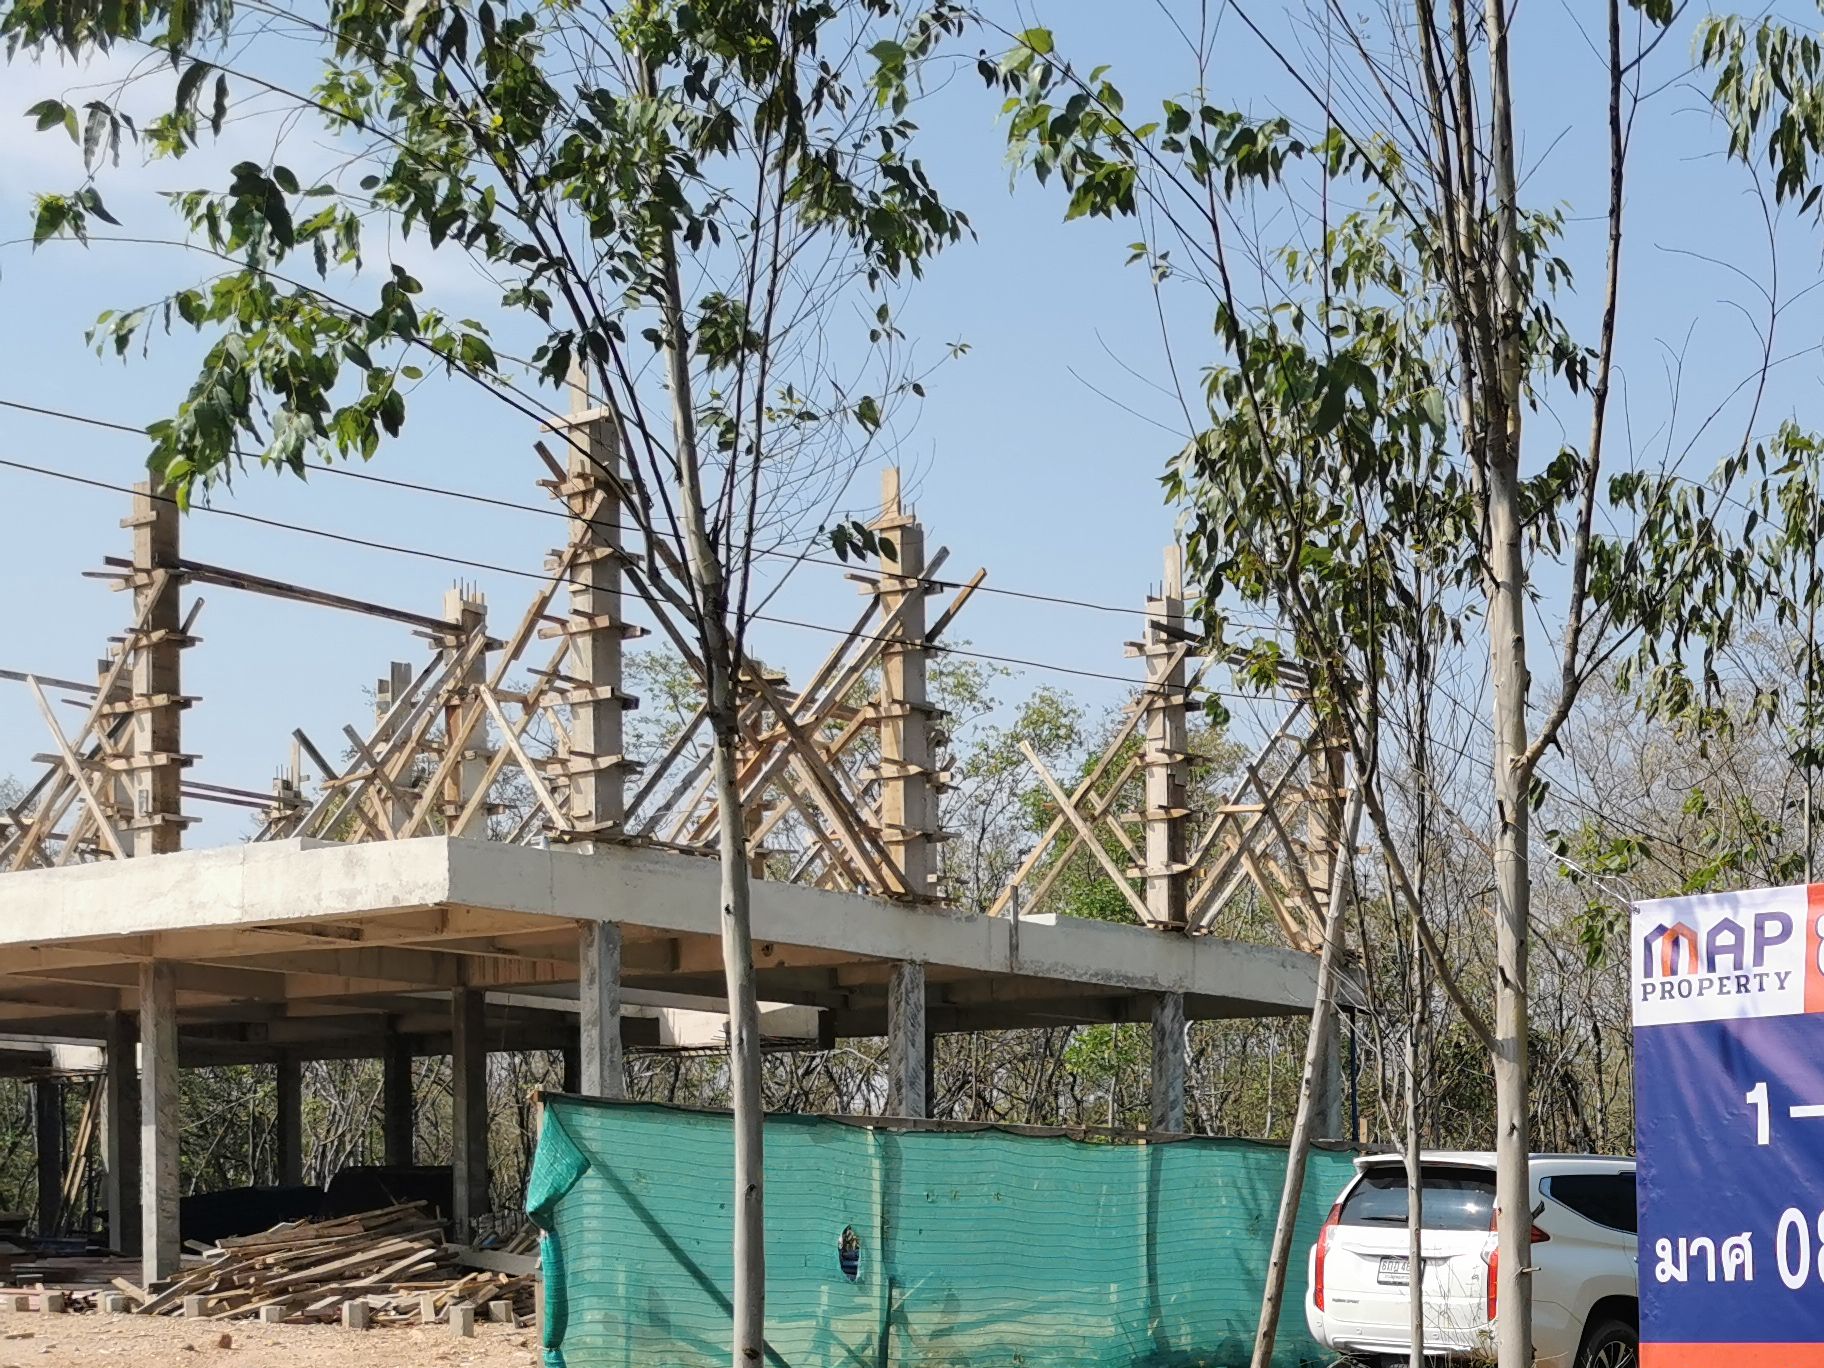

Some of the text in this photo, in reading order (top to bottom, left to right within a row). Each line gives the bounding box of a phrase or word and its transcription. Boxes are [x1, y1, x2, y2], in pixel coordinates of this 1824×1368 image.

[1643, 911, 1793, 979] MAP
[1641, 970, 1793, 1002] PROPERTY
[1655, 1231, 1754, 1283] มาศ
